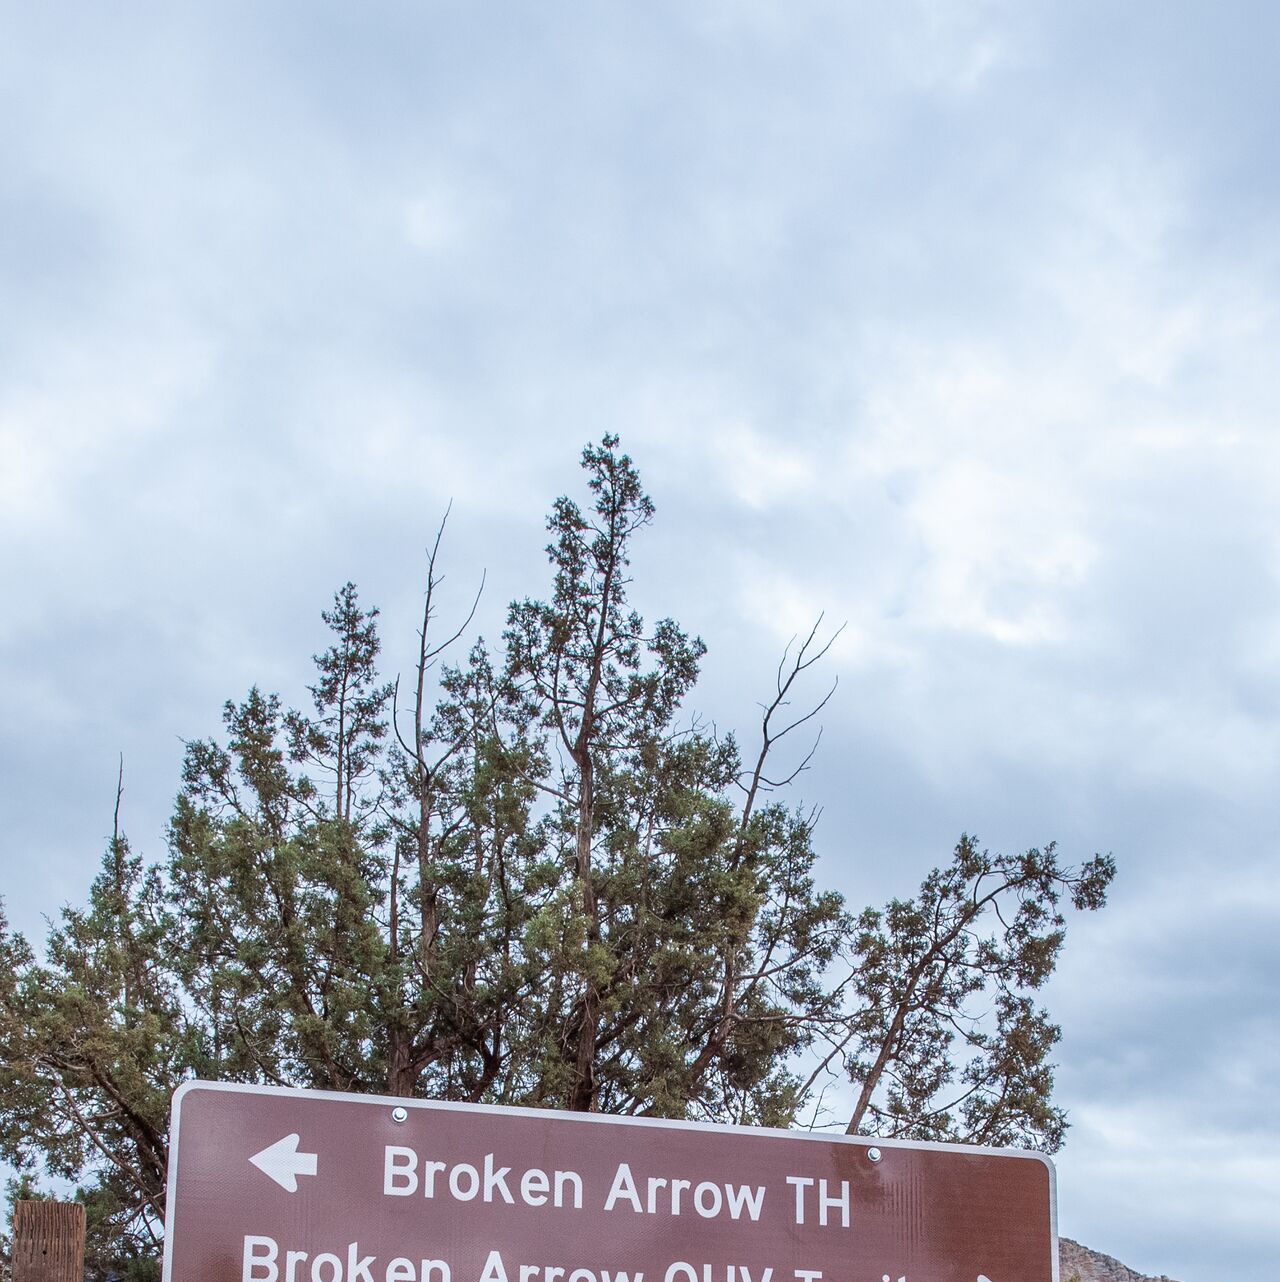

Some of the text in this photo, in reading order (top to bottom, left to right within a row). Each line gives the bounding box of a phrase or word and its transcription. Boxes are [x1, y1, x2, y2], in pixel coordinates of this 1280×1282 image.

[383, 1145, 850, 1228] Broken Arrow TH
